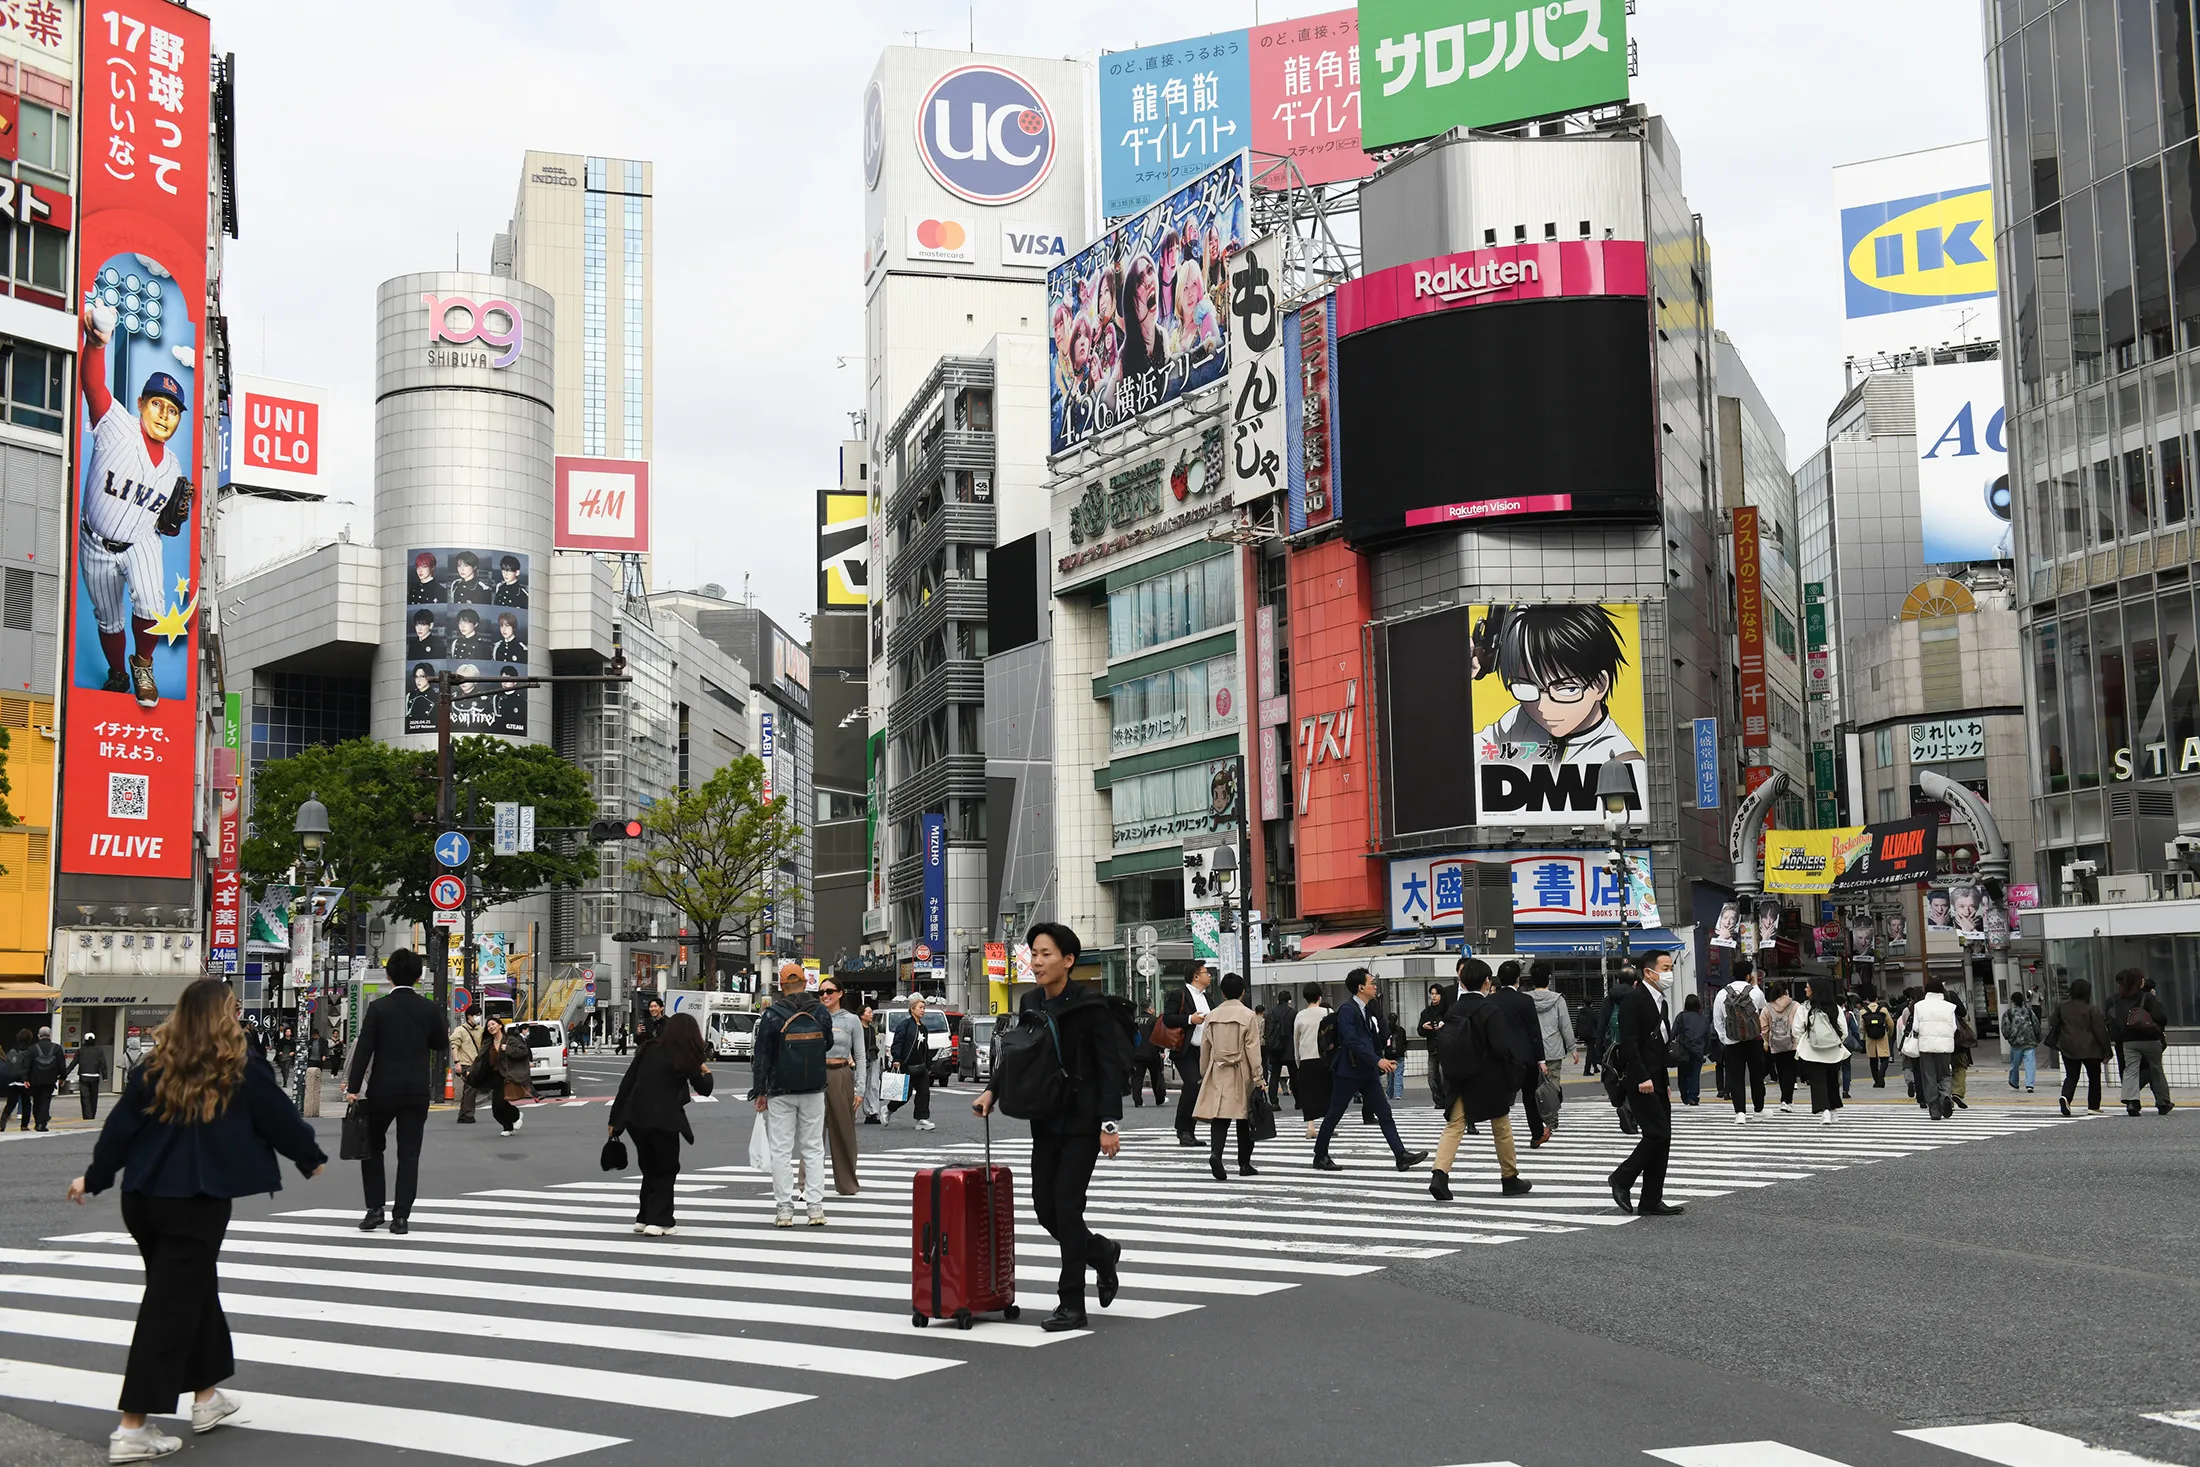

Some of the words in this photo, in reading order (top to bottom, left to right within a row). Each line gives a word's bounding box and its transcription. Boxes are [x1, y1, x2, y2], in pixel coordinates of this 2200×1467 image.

[1110, 41, 1240, 76] のど、直接、うるおう
[1375, 0, 1608, 97] サロンパス
[149, 26, 185, 195] 野球って
[1131, 70, 1220, 124] 龍角散
[1272, 91, 1362, 141] ダイレク
[1120, 115, 1237, 167] ダイレクト
[1288, 141, 1335, 157] スティック
[531, 173, 578, 187] INDIGO
[1135, 166, 1180, 183] スティック
[919, 250, 964, 259] mastercard
[1005, 232, 1067, 257] VISA
[1874, 219, 1989, 280] IK
[1414, 258, 1539, 301] Rakuten
[421, 293, 524, 369] 109
[428, 350, 487, 368] SHIBUYA
[1230, 250, 1280, 488] もんじゃ
[253, 403, 306, 436] UNI
[252, 434, 311, 465] QLO
[105, 470, 167, 514] LIVE
[578, 488, 626, 521] H&M
[1449, 502, 1488, 518] Rakuten
[1489, 499, 1521, 513] Vision
[1736, 513, 1759, 644] クスリのことなら
[1741, 653, 1767, 737] 三千里
[93, 720, 171, 744] イチナナで、
[226, 719, 238, 746] レイク
[763, 727, 772, 756] LABI
[1929, 723, 1983, 741] れいわ
[99, 742, 164, 763] 叶えよう。
[1481, 740, 1558, 760] キルアオ
[1699, 723, 1715, 804] 大盛堂商事ビル
[1912, 741, 1984, 764] クリニック
[223, 820, 236, 854] アコム
[504, 806, 515, 851] 渋谷駅前
[1880, 828, 1926, 861] ALVARK
[90, 833, 164, 860] 17LIVE
[931, 824, 940, 867] MIZUHO
[1779, 848, 1827, 871] ROCKERS
[1401, 863, 1632, 914] 大盛書店
[214, 871, 239, 946] スギ薬局
[929, 897, 939, 941] みずほ銀行
[1591, 909, 1613, 917] BOOKS
[984, 943, 1004, 951] NEW
[349, 984, 358, 1043] SMOKING
